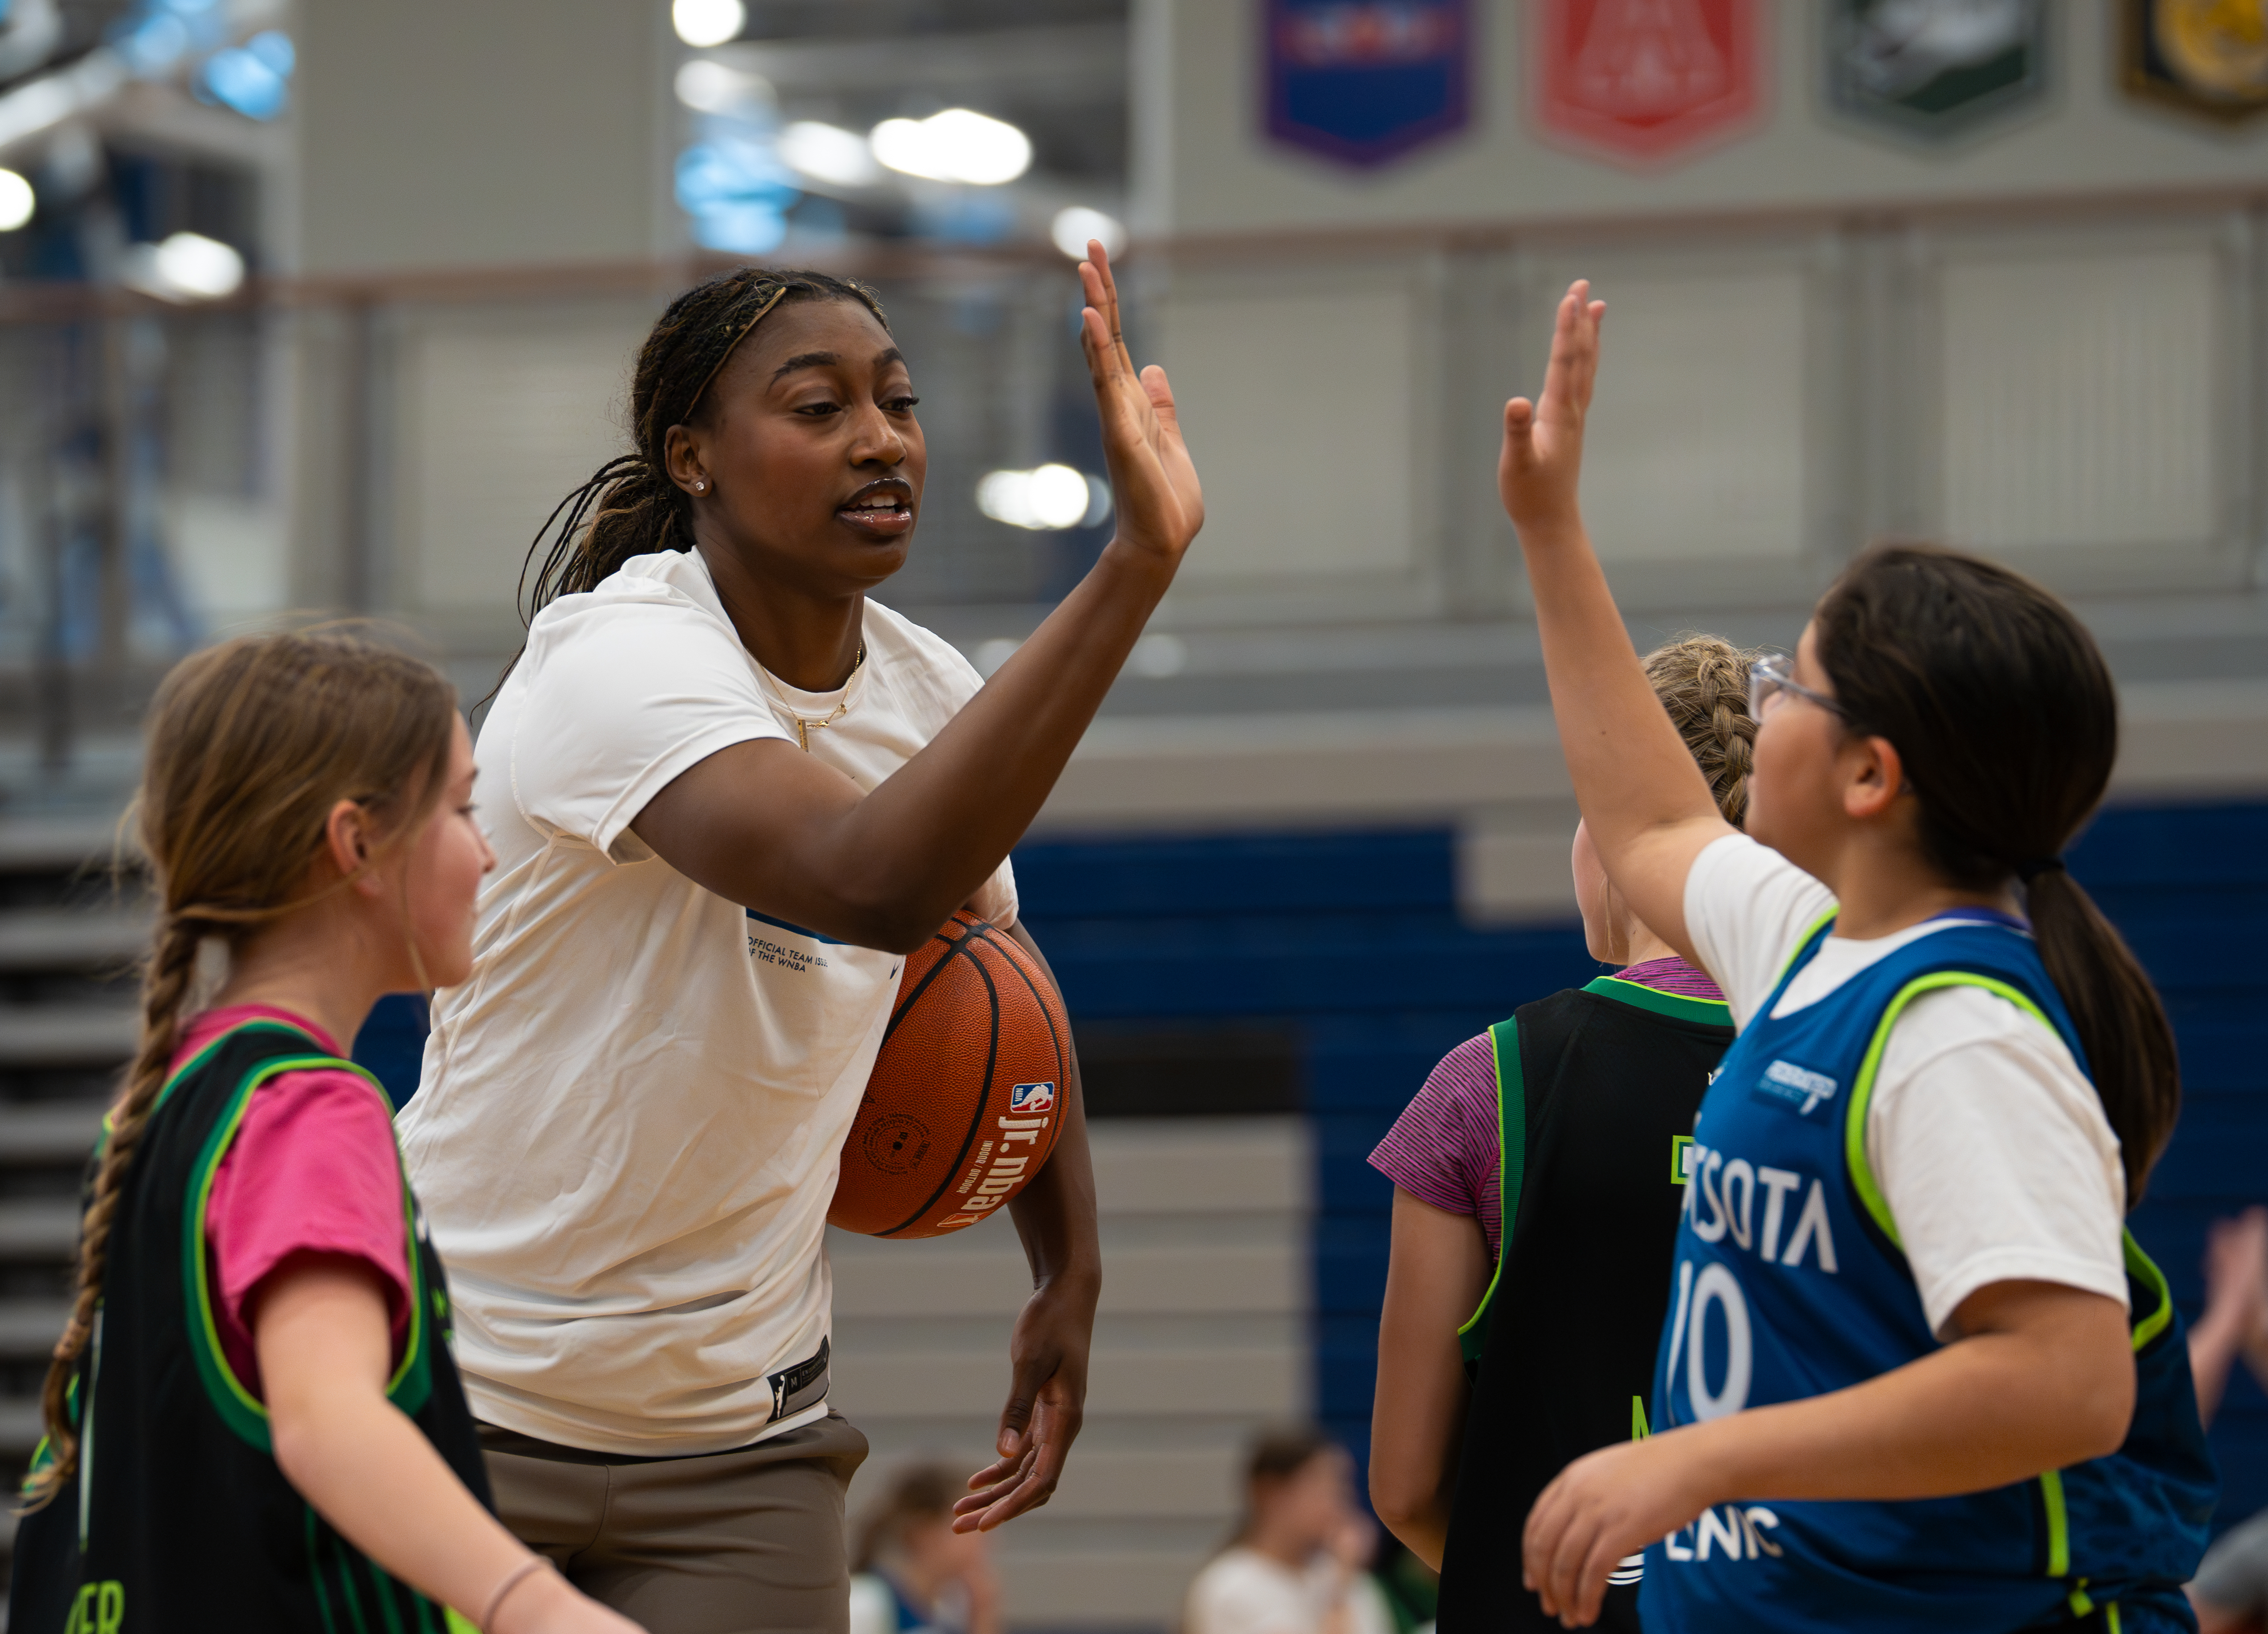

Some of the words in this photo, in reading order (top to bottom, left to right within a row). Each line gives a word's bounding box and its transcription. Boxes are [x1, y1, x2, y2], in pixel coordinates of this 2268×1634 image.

[748, 936, 785, 956] OFFICIAL
[789, 950, 813, 965] TEAM
[758, 950, 776, 963] THE
[778, 956, 806, 973] WNBA
[1015, 1087, 1024, 1102] NBA
[974, 1140, 994, 1164] INDOOR
[956, 1168, 982, 1194] OUTDOOR
